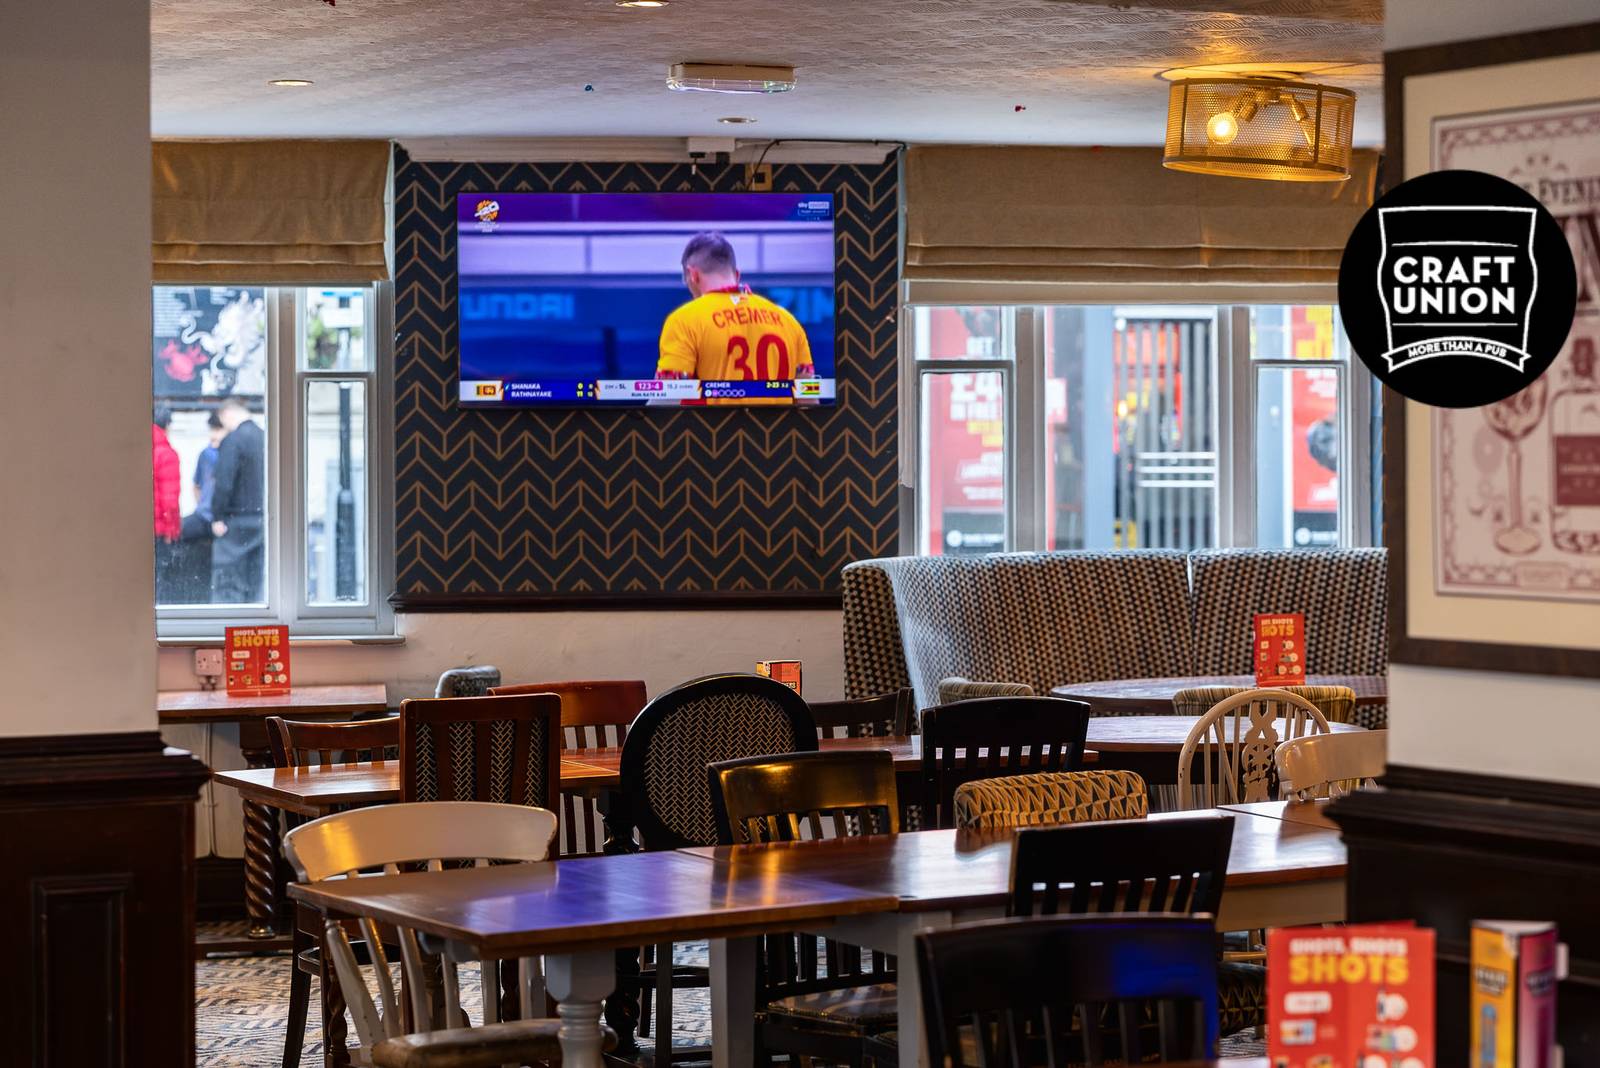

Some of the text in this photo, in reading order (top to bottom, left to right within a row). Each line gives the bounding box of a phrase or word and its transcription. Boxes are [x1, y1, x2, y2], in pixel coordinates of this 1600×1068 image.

[712, 306, 784, 329] CREMER
[726, 333, 790, 380] 30
[511, 390, 553, 398] RATHNAYAKE
[233, 635, 280, 648] SHOTS
[1289, 953, 1409, 985] SHOTS
